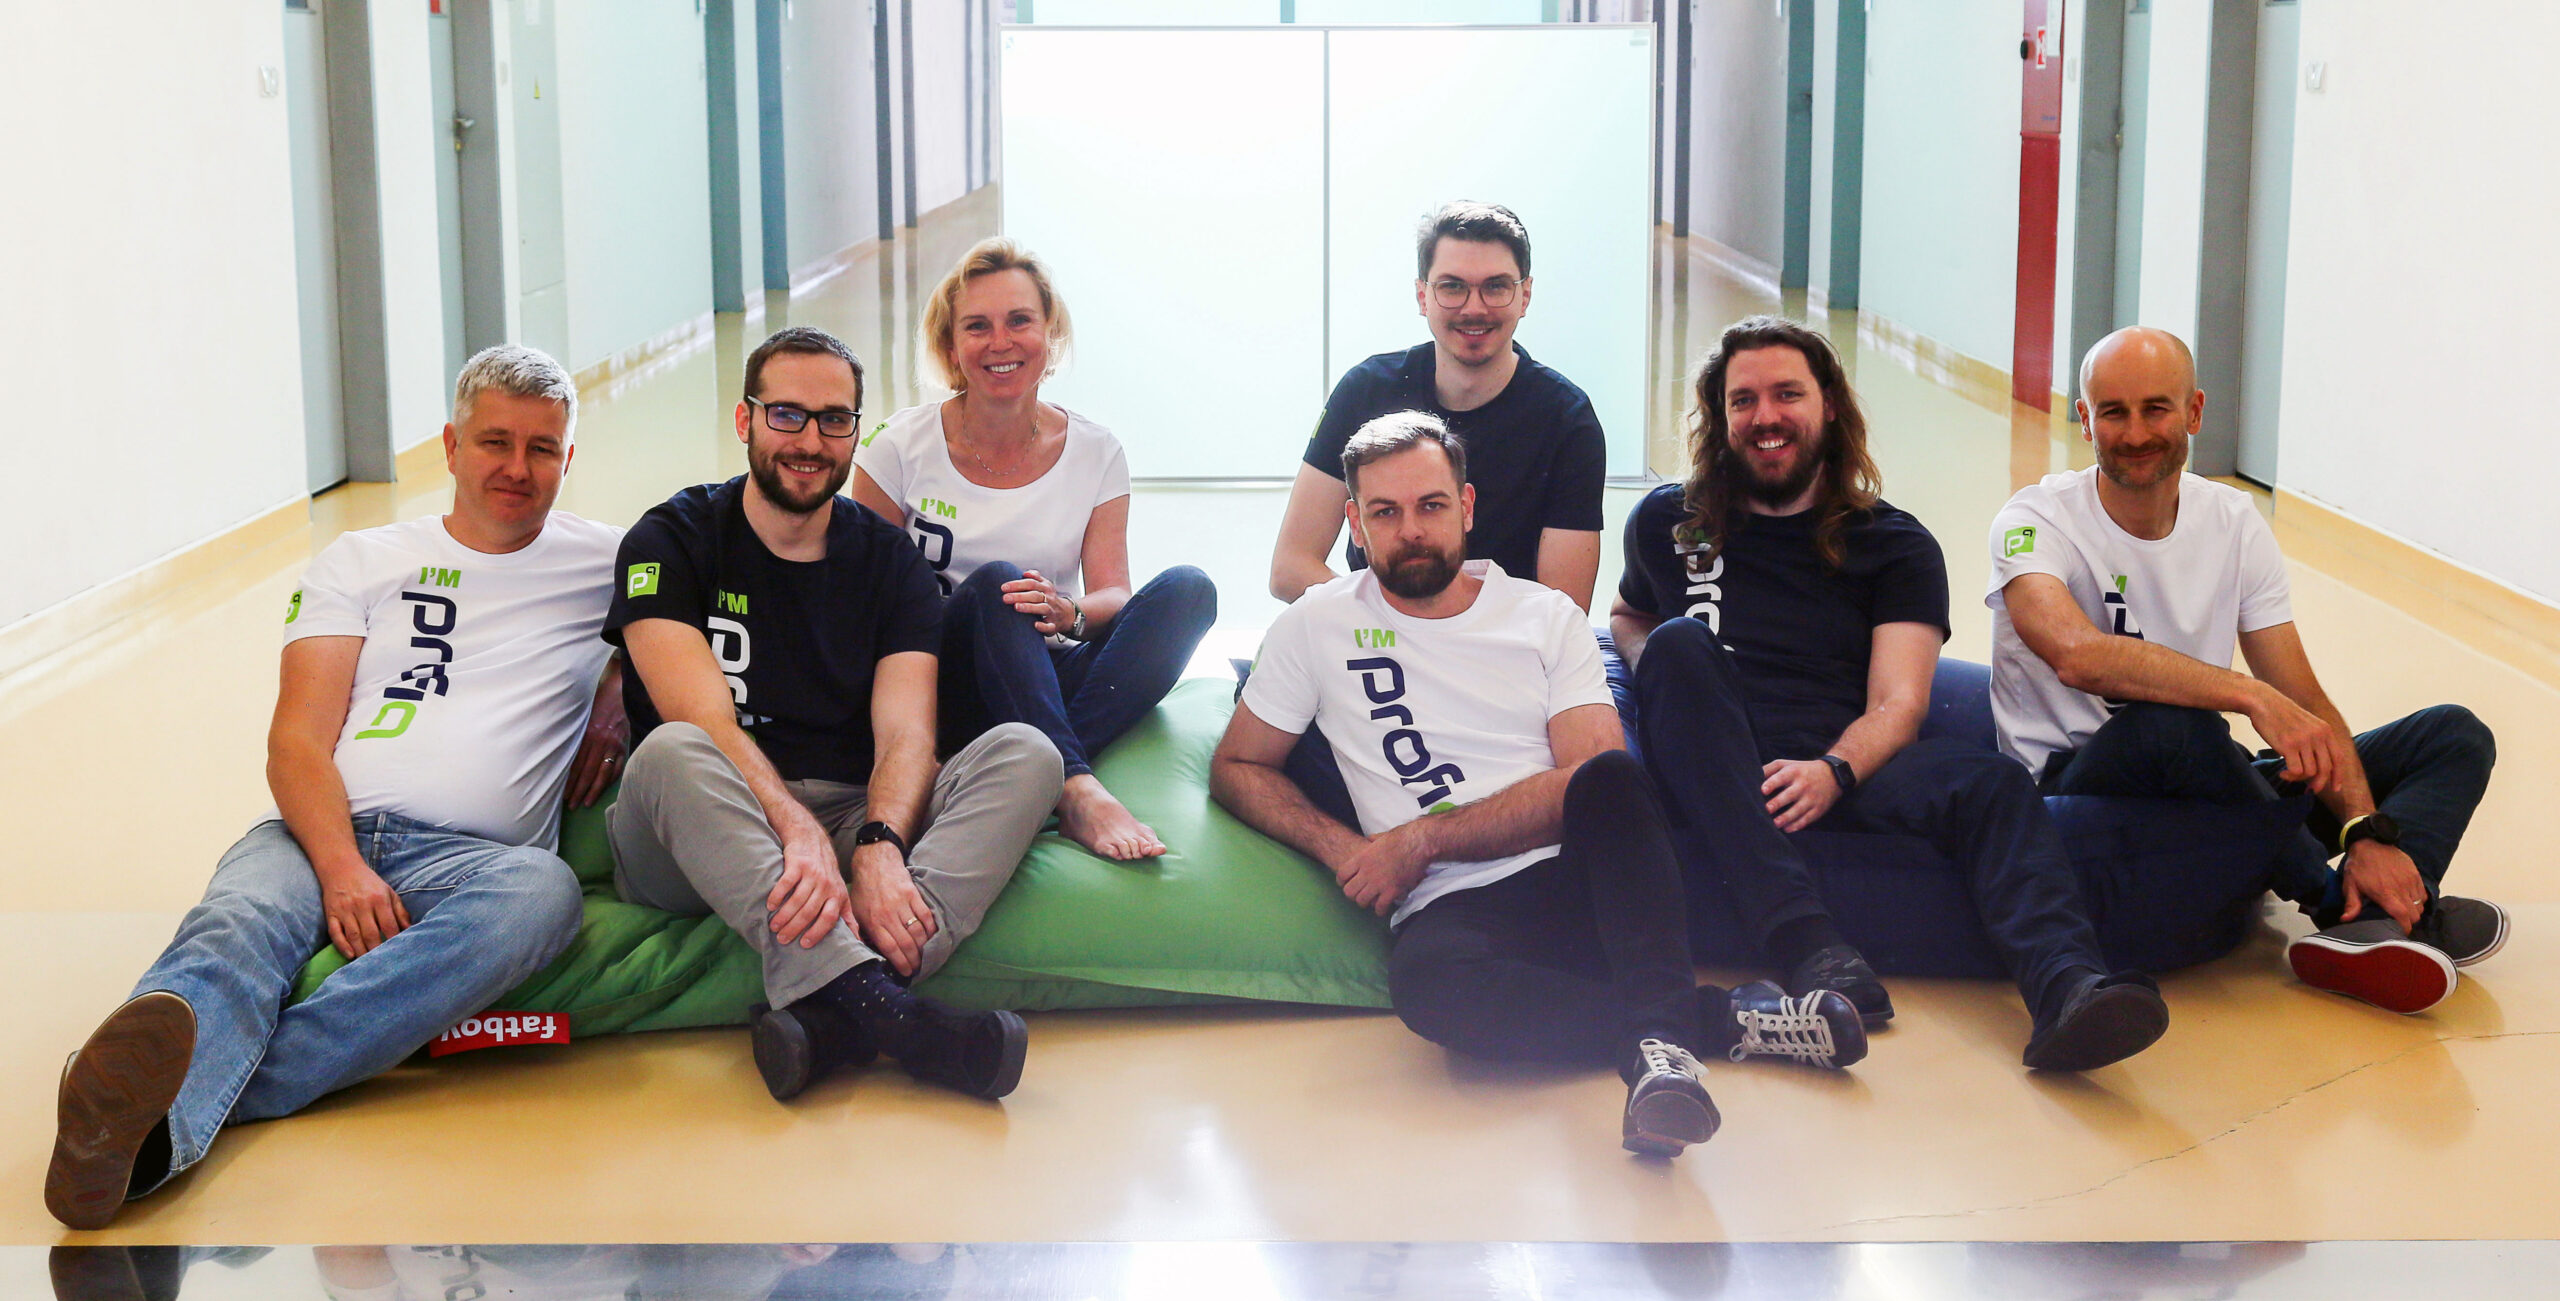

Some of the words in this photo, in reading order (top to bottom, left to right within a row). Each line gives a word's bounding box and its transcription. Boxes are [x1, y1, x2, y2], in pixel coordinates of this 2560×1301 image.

[921, 498, 957, 519] I'M
[419, 567, 462, 588] I'M
[1354, 629, 1396, 648] I'M
[1347, 657, 1466, 815] profi
